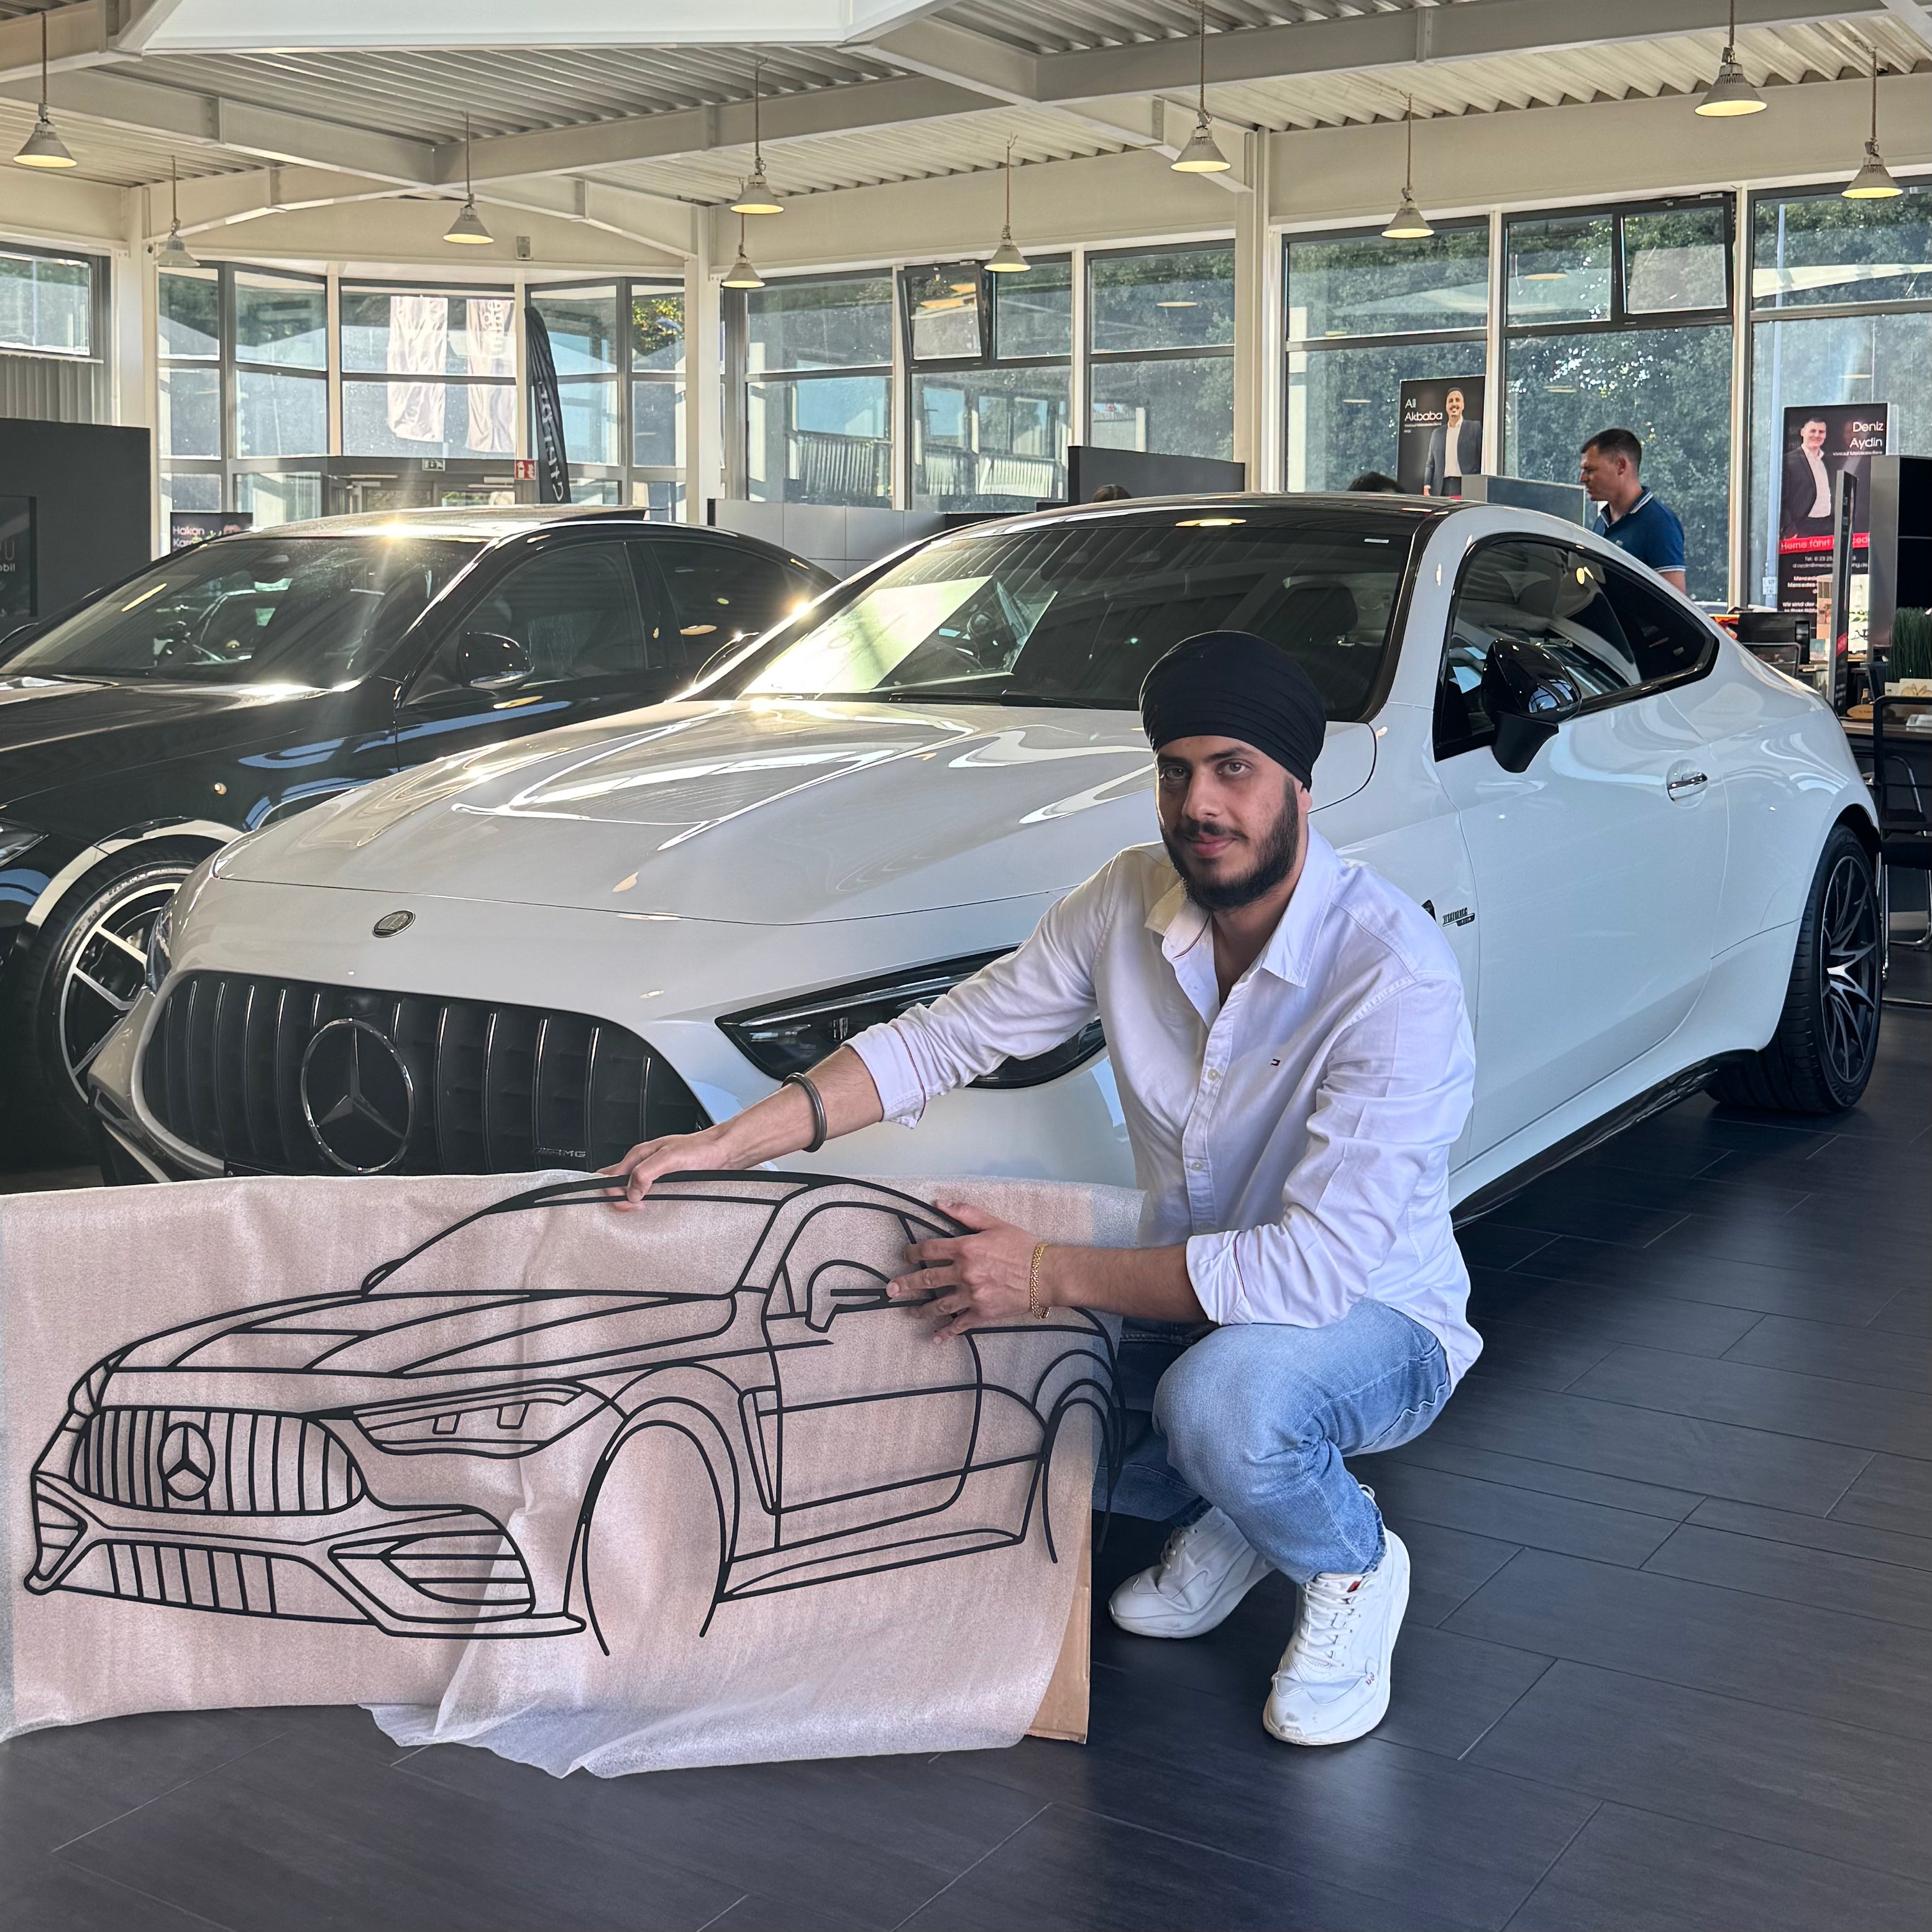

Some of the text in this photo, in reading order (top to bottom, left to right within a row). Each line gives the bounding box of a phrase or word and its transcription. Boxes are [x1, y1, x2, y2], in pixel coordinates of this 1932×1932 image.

[1404, 411, 1443, 421] Akbaba
[1852, 421, 1884, 432] Deniz
[1849, 437, 1882, 449] Aydin
[173, 526, 205, 536] Hakan
